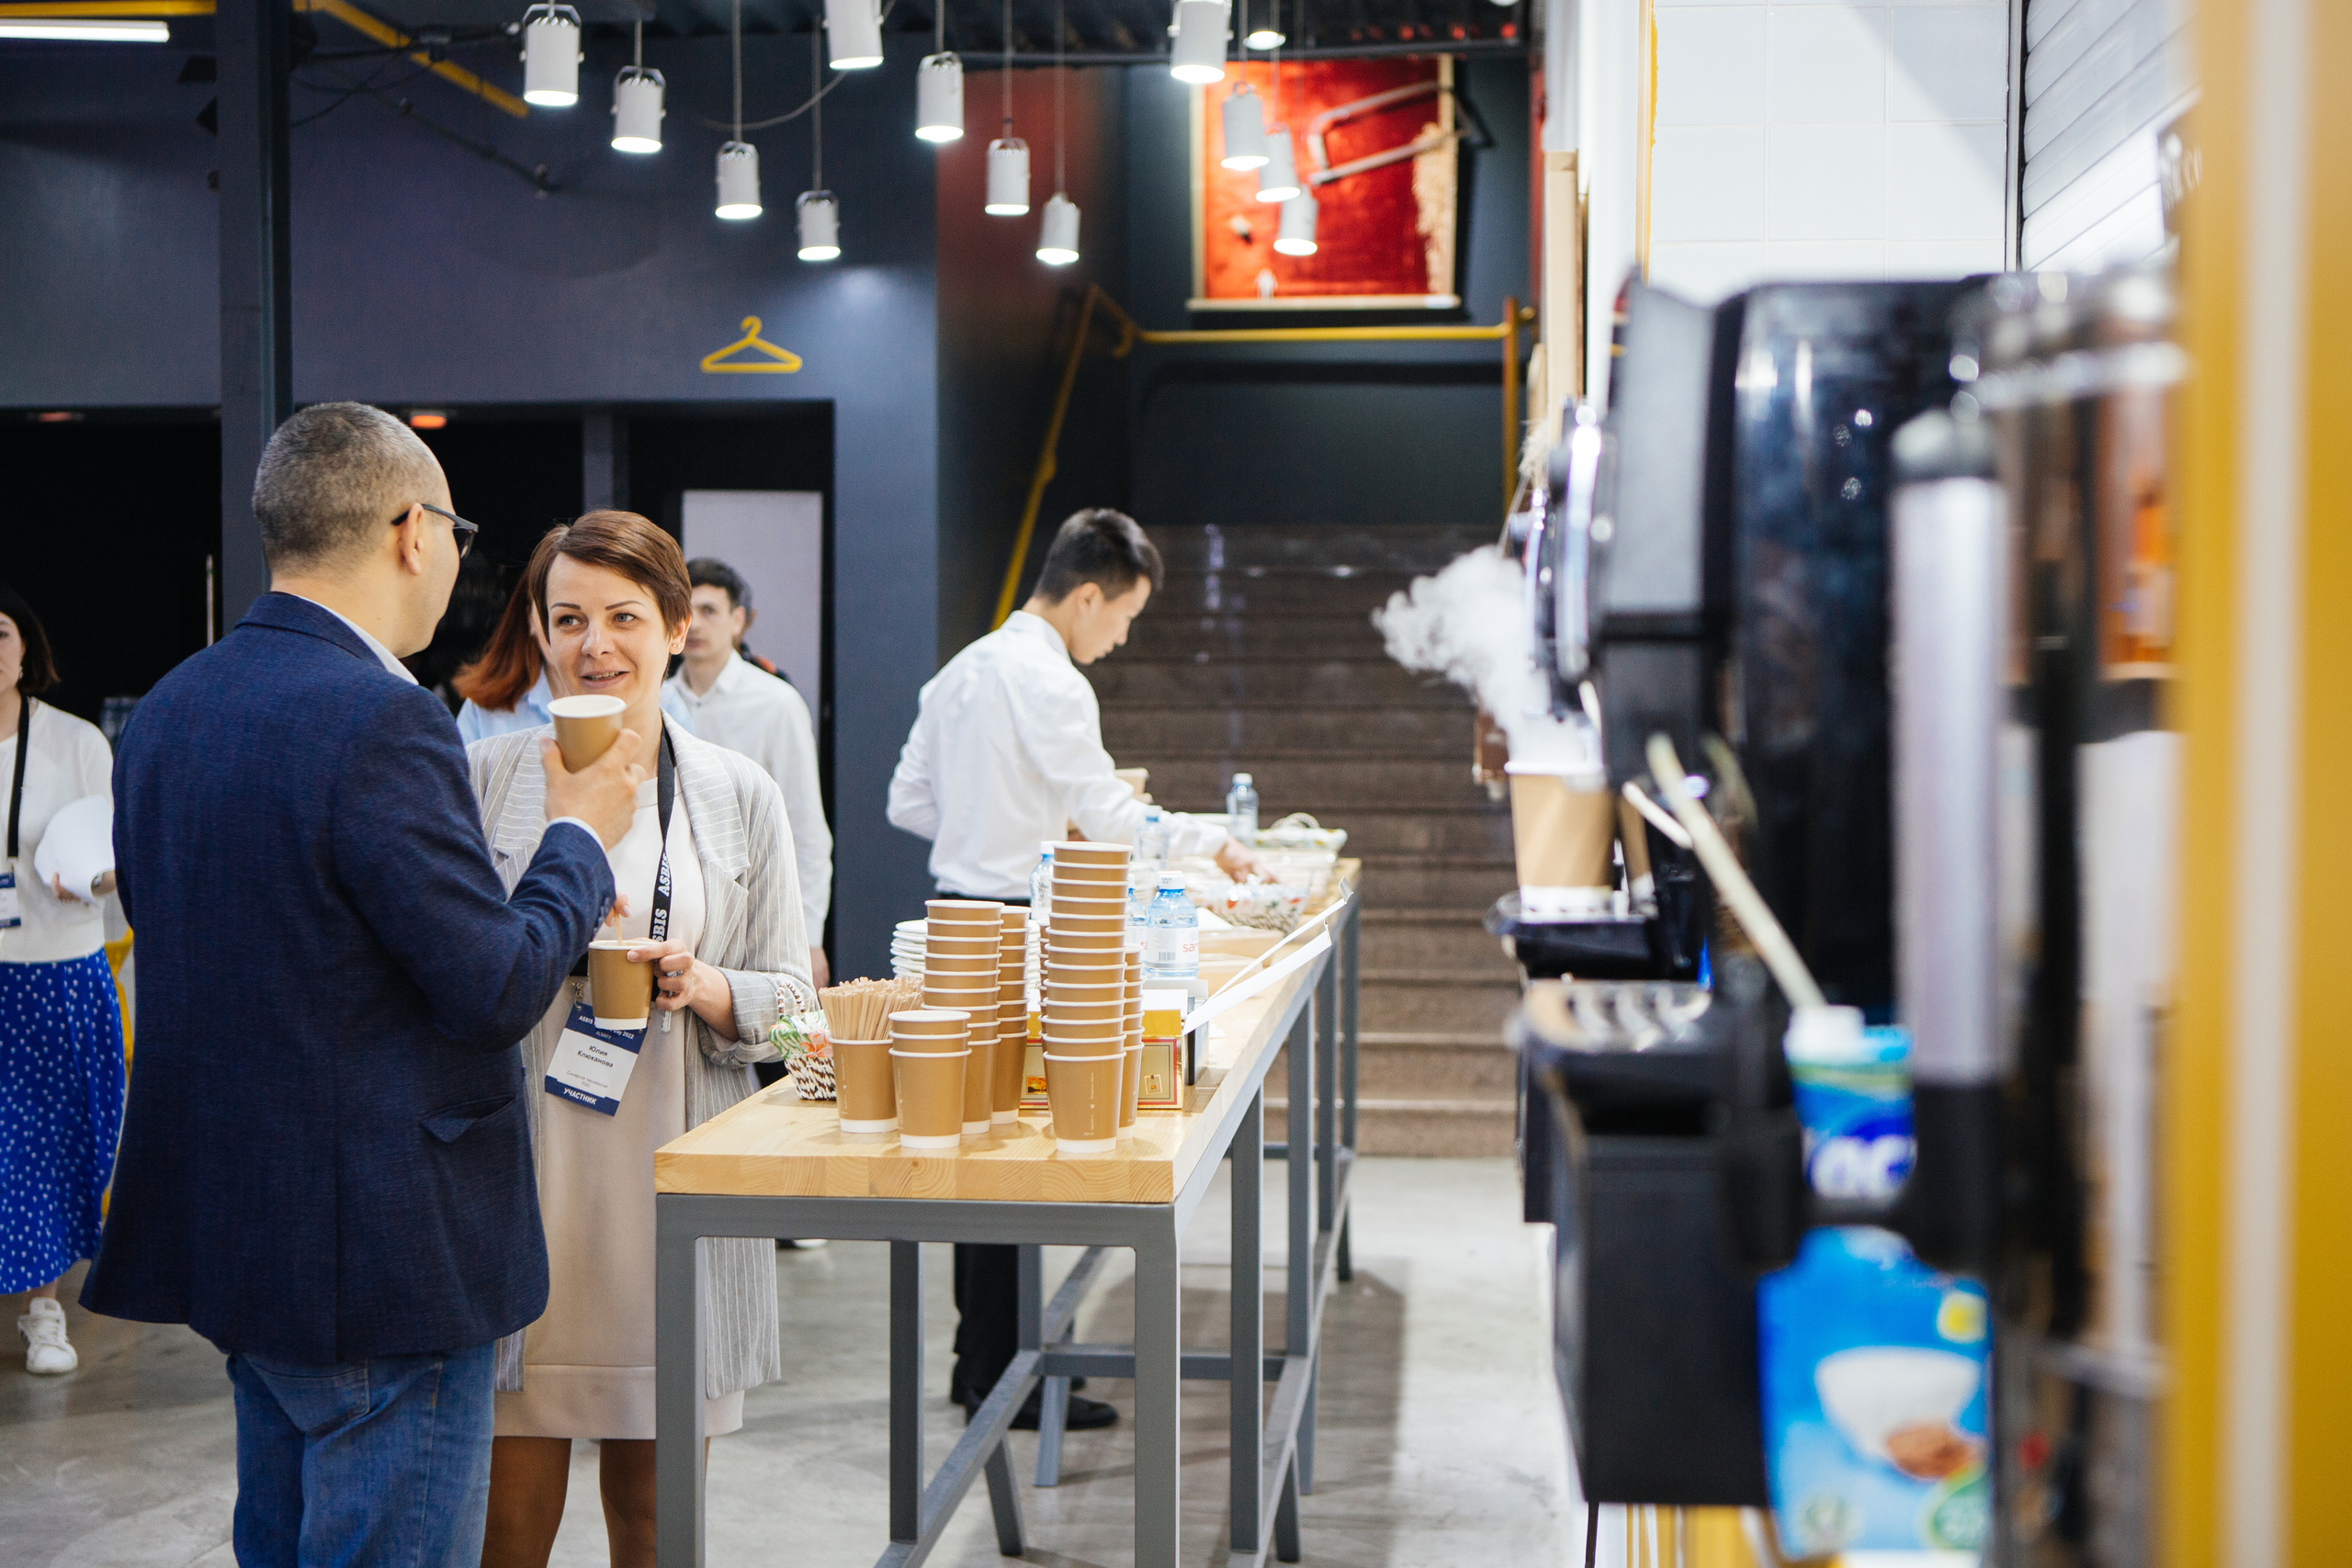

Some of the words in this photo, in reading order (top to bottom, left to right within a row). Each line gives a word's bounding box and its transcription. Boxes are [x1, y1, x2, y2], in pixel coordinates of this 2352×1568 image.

[652, 908, 668, 942] SBIS
[579, 1015, 594, 1024] ASBIS
[623, 1031, 635, 1039] 2022
[577, 1050, 614, 1068] Клюканова
[589, 1044, 608, 1056] Юлия
[563, 1087, 597, 1105] УЧАСТНИК
